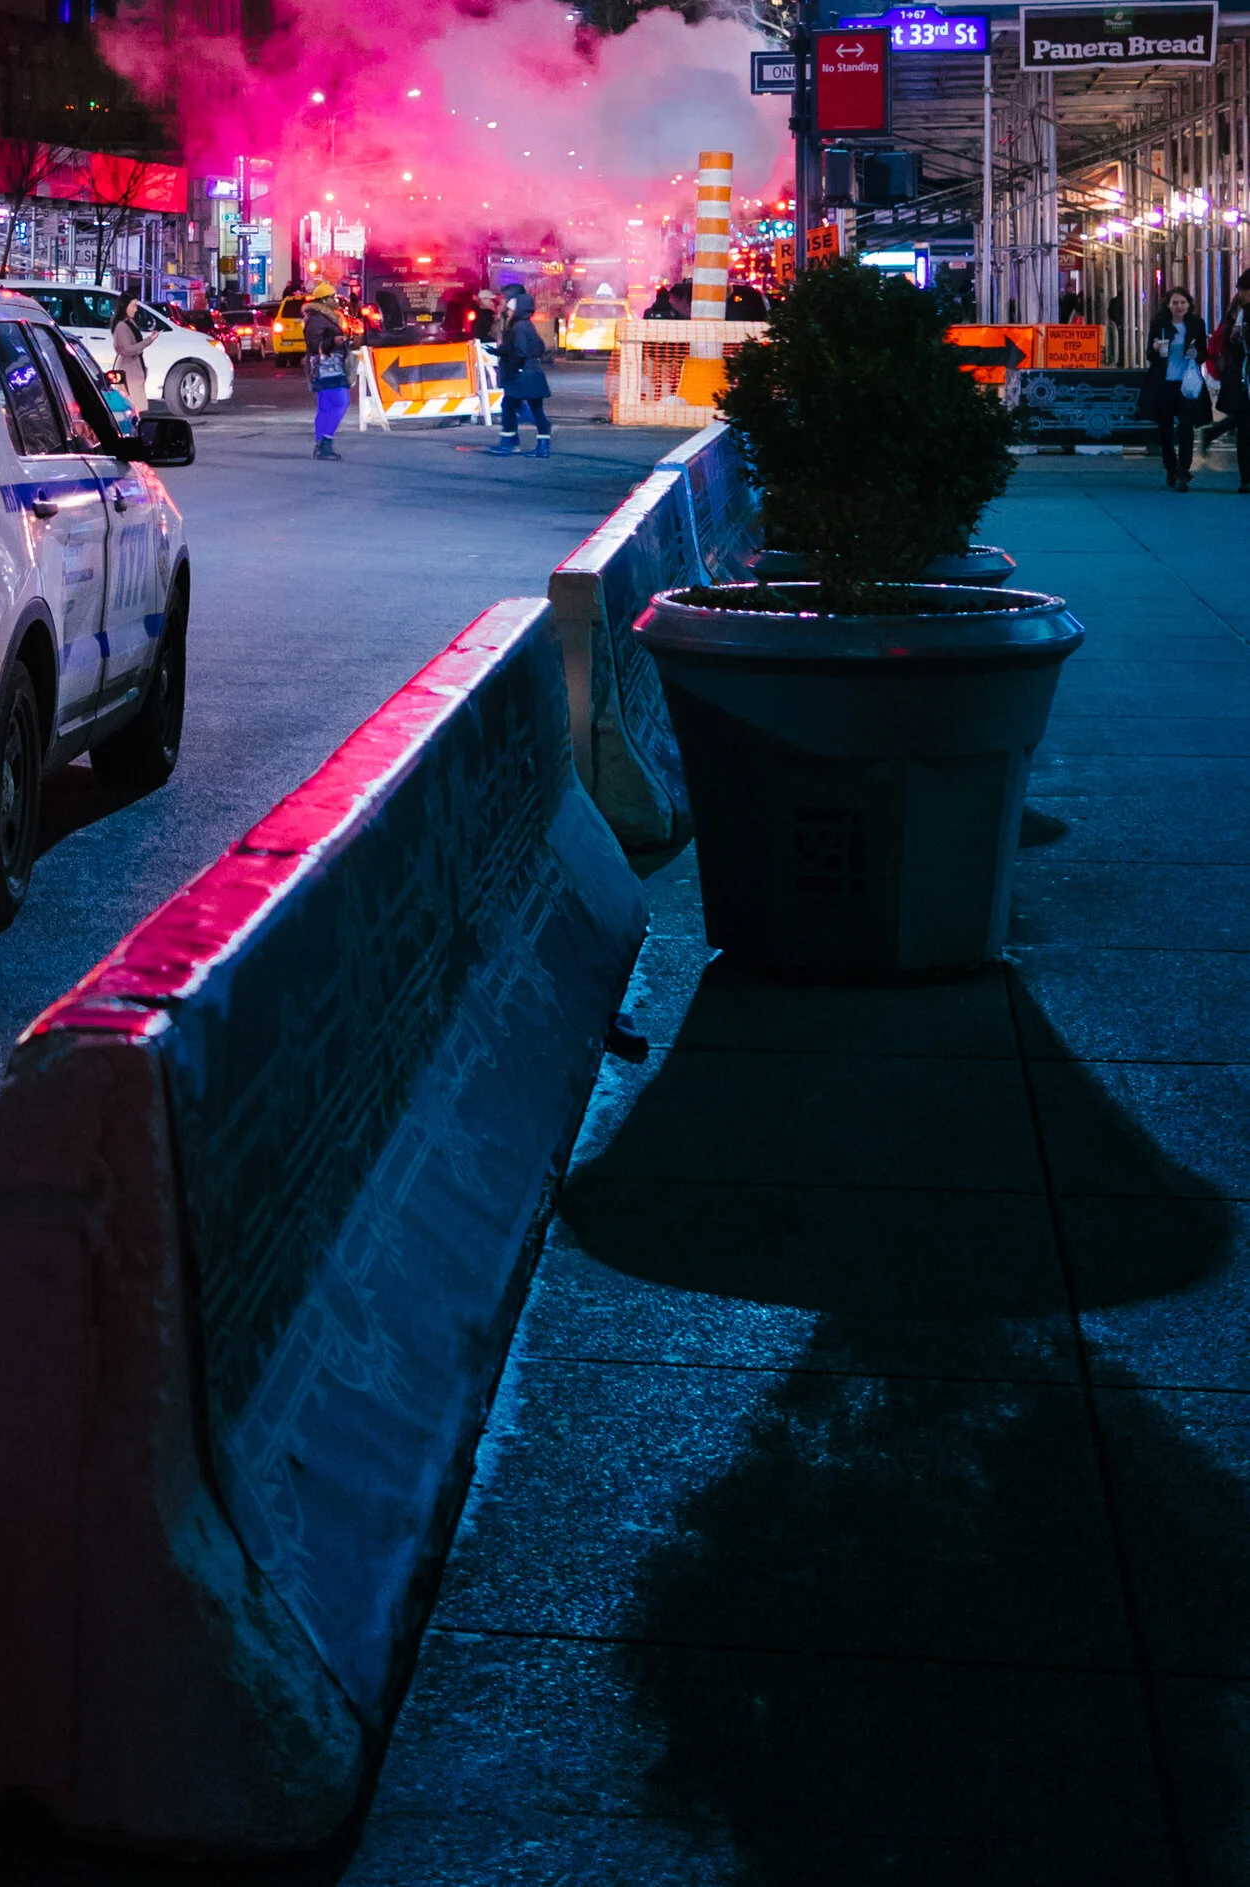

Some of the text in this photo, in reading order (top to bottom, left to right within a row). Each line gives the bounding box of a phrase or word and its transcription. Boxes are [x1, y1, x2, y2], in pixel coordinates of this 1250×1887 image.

[909, 22, 949, 45] 33rd
[955, 23, 978, 45] St
[1032, 34, 1206, 61] Panera Bread
[821, 62, 879, 74] No Standing
[781, 233, 833, 258] RISE
[56, 249, 79, 262] GIT
[1050, 330, 1095, 339] WATCH YOUR
[1063, 341, 1082, 350] STEP
[1048, 352, 1096, 362] ROAD PLATES
